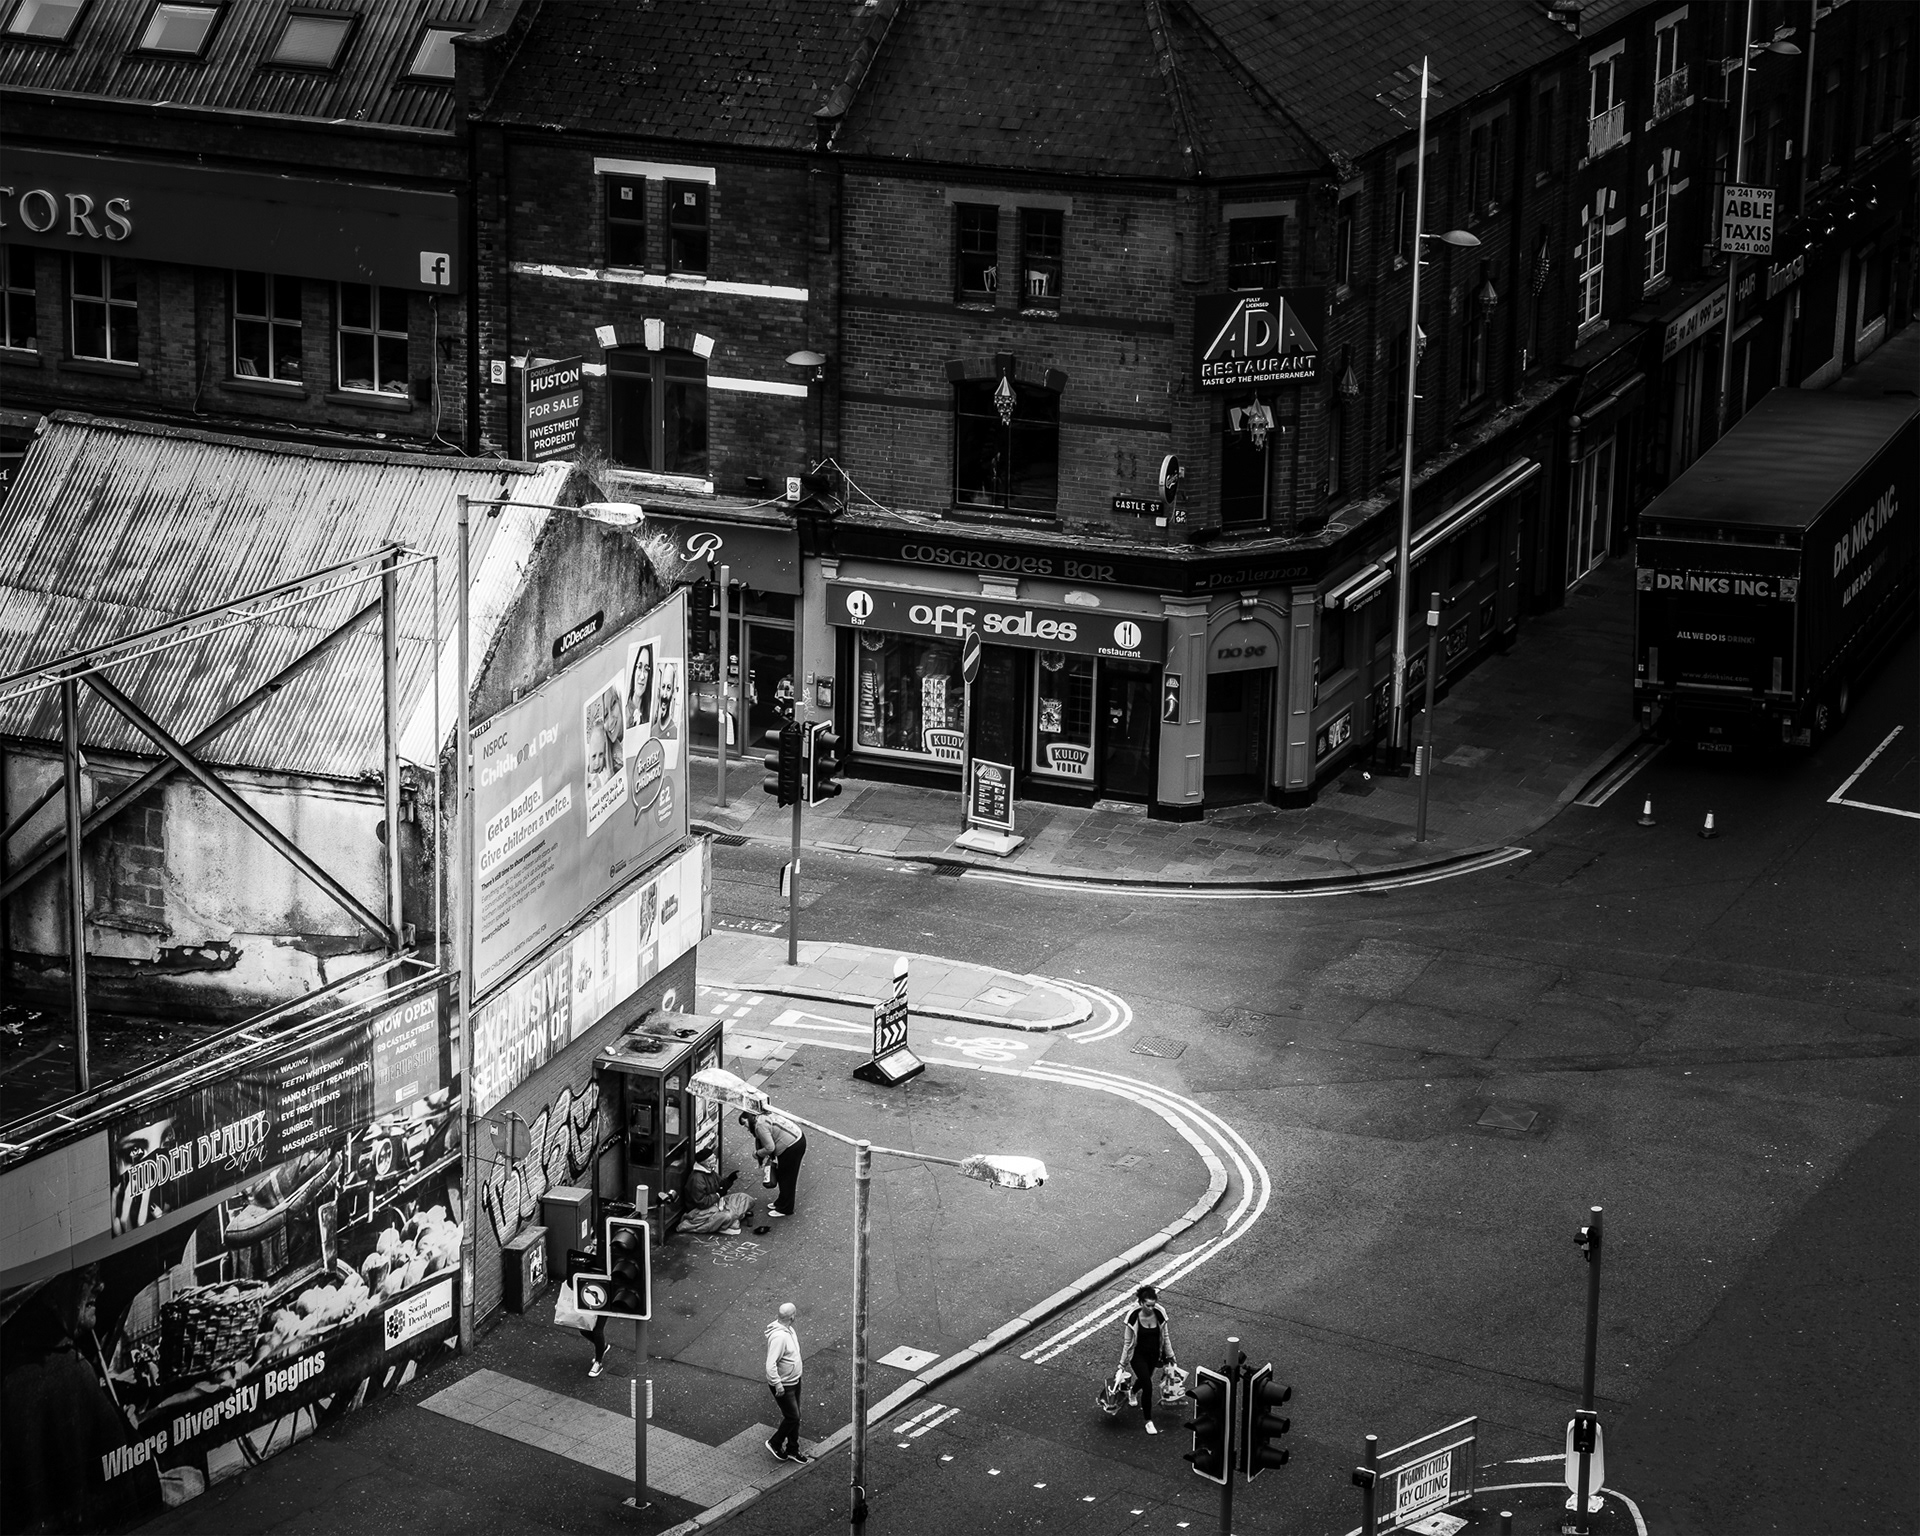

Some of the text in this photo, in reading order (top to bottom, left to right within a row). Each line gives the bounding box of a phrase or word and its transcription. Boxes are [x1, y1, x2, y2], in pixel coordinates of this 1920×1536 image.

[1737, 189, 1753, 197] 241
[1756, 190, 1773, 199] 999
[1726, 200, 1772, 220] ABLE
[1724, 224, 1772, 241] TAXIS
[1734, 242, 1750, 251] 241
[1753, 244, 1770, 253] 000
[1203, 295, 1318, 360] ADA
[1201, 355, 1316, 377] RESTAURANT
[530, 368, 580, 393] HUSTON
[1202, 370, 1315, 386] TASTE OF THE MEDITERRANEAN
[529, 396, 580, 419] FOR SALE
[529, 417, 580, 439] INVESTMENT
[534, 430, 577, 451] PROPERTY
[1115, 500, 1146, 512] CASTLE
[1876, 484, 1899, 533] INC.
[900, 544, 1053, 575] COSGROVES
[1734, 579, 1777, 598] INC.
[851, 616, 866, 626] Bar
[908, 603, 1078, 642] off sales
[560, 620, 597, 653] JCDecaux
[1676, 630, 1692, 640] ALL
[1692, 631, 1704, 641] WE
[1704, 632, 1718, 641] DO
[1718, 634, 1727, 642] IS
[1098, 646, 1141, 658] restaurant
[483, 731, 508, 760] NSPCC
[539, 722, 560, 750] Day
[933, 734, 964, 749] KULOV
[936, 748, 961, 761] VODKA
[1054, 748, 1086, 762] KULOV
[1056, 762, 1083, 775] VODKA
[487, 790, 541, 842] Get a badge.
[480, 796, 570, 871] Give children a voice.
[374, 995, 437, 1038] NOW OPEN
[474, 961, 570, 1069] EXCLUSIVE
[387, 1031, 410, 1049] CASTLE
[410, 1019, 435, 1038] STREET
[396, 1038, 418, 1055] ABOVE
[473, 1005, 569, 1104] SELECTION OF
[280, 1056, 309, 1074] WAXING
[281, 1057, 344, 1089] TEETH WHITENING
[281, 1060, 369, 1106] HAND & FEET TREATMENTS
[281, 1089, 341, 1122] EYE TREATMENTS
[281, 1117, 314, 1138] SUNBEDS
[128, 1109, 266, 1199] HIDDEN BEAUTY
[281, 1131, 319, 1154] MASSAGES
[408, 1298, 428, 1316] Social
[408, 1301, 450, 1327] Development
[101, 1350, 326, 1482] Where Diversity Begins
[1429, 1453, 1450, 1476] CYCLES
[1399, 1488, 1414, 1509] KEY
[1415, 1472, 1448, 1501] CUTTING
